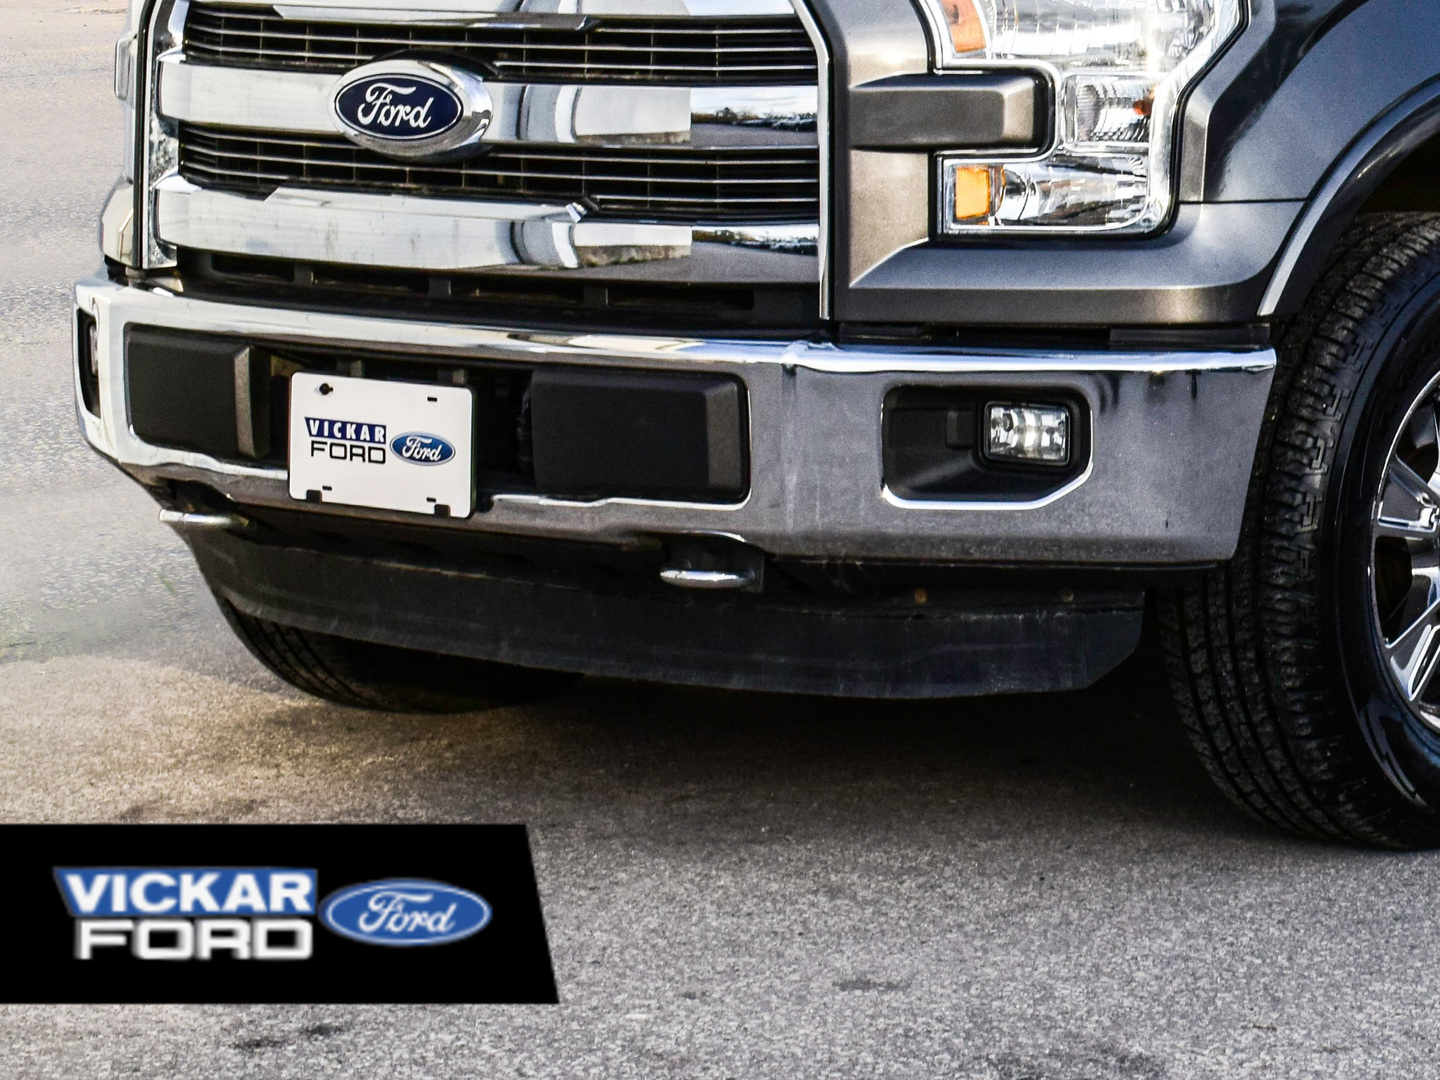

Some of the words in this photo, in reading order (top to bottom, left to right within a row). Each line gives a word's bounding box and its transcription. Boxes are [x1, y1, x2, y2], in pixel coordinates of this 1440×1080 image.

[357, 82, 435, 129] Ford
[308, 418, 386, 443] VICKAR
[401, 435, 443, 463] Ford
[310, 440, 387, 465] FORD
